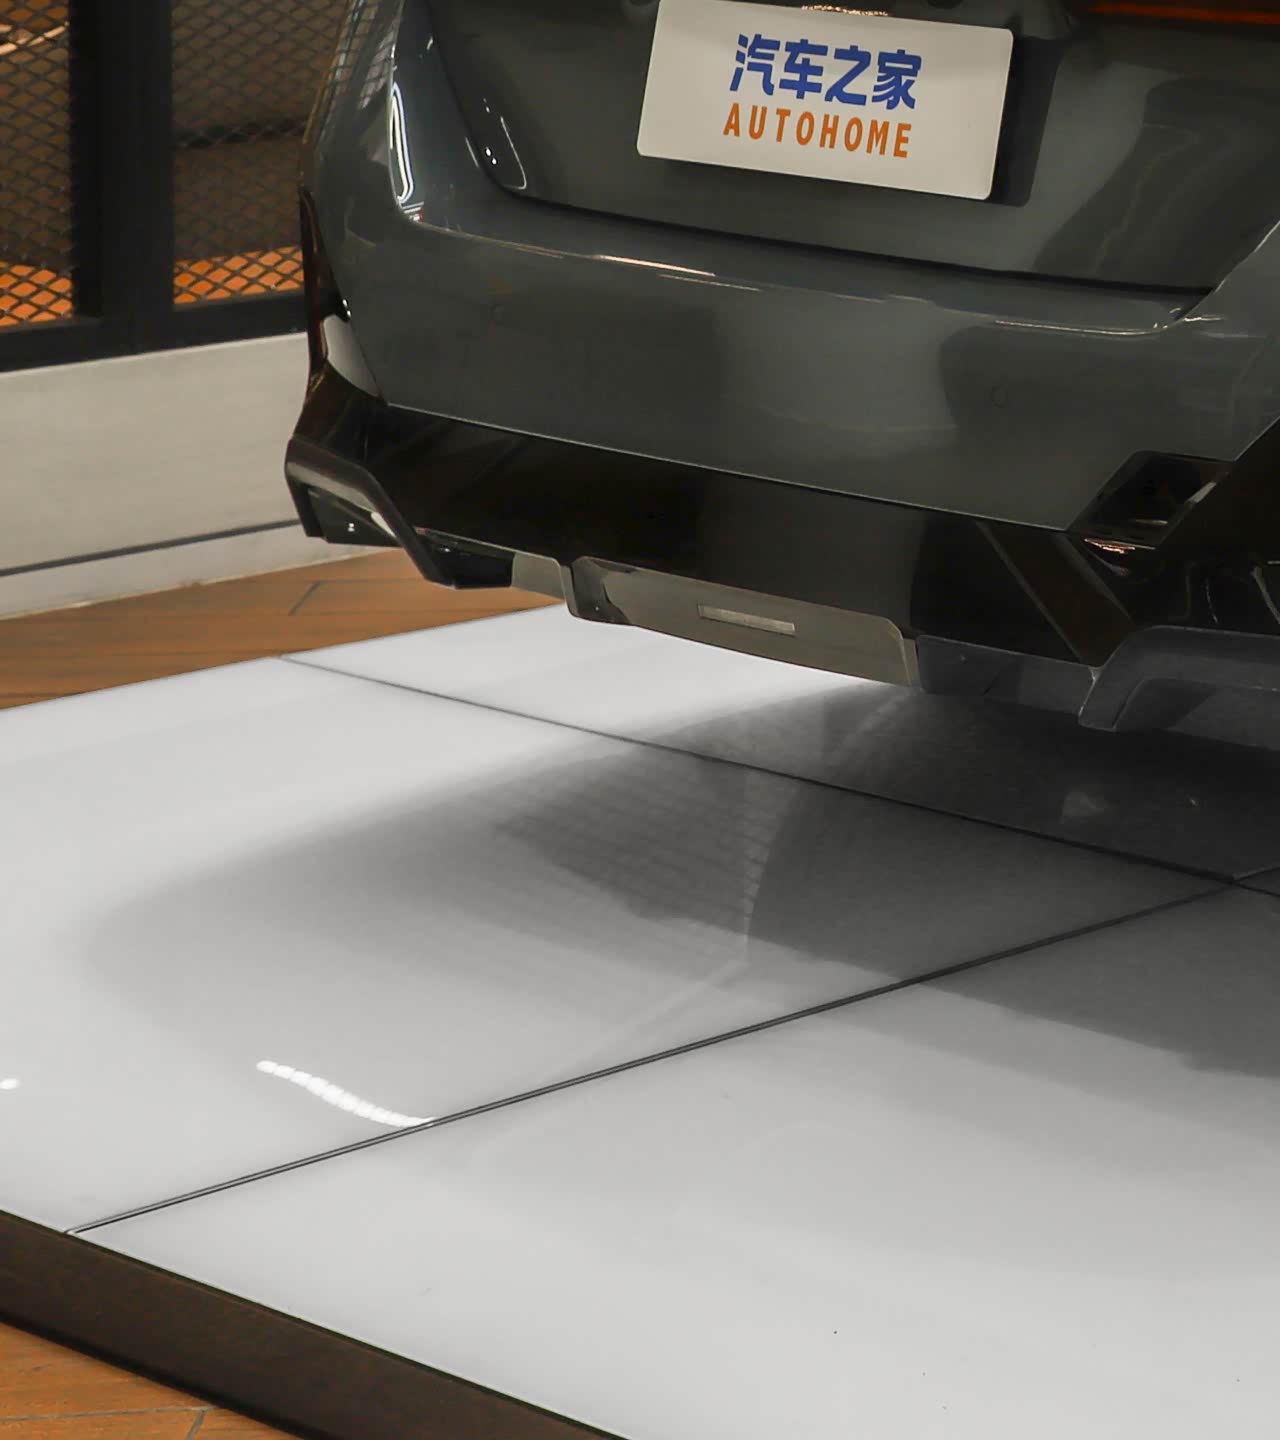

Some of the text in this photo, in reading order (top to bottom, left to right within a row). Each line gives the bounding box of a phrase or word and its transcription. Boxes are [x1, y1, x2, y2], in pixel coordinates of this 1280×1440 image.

[730, 33, 922, 110] 汽车之家
[723, 102, 912, 159] AUTOHOME
